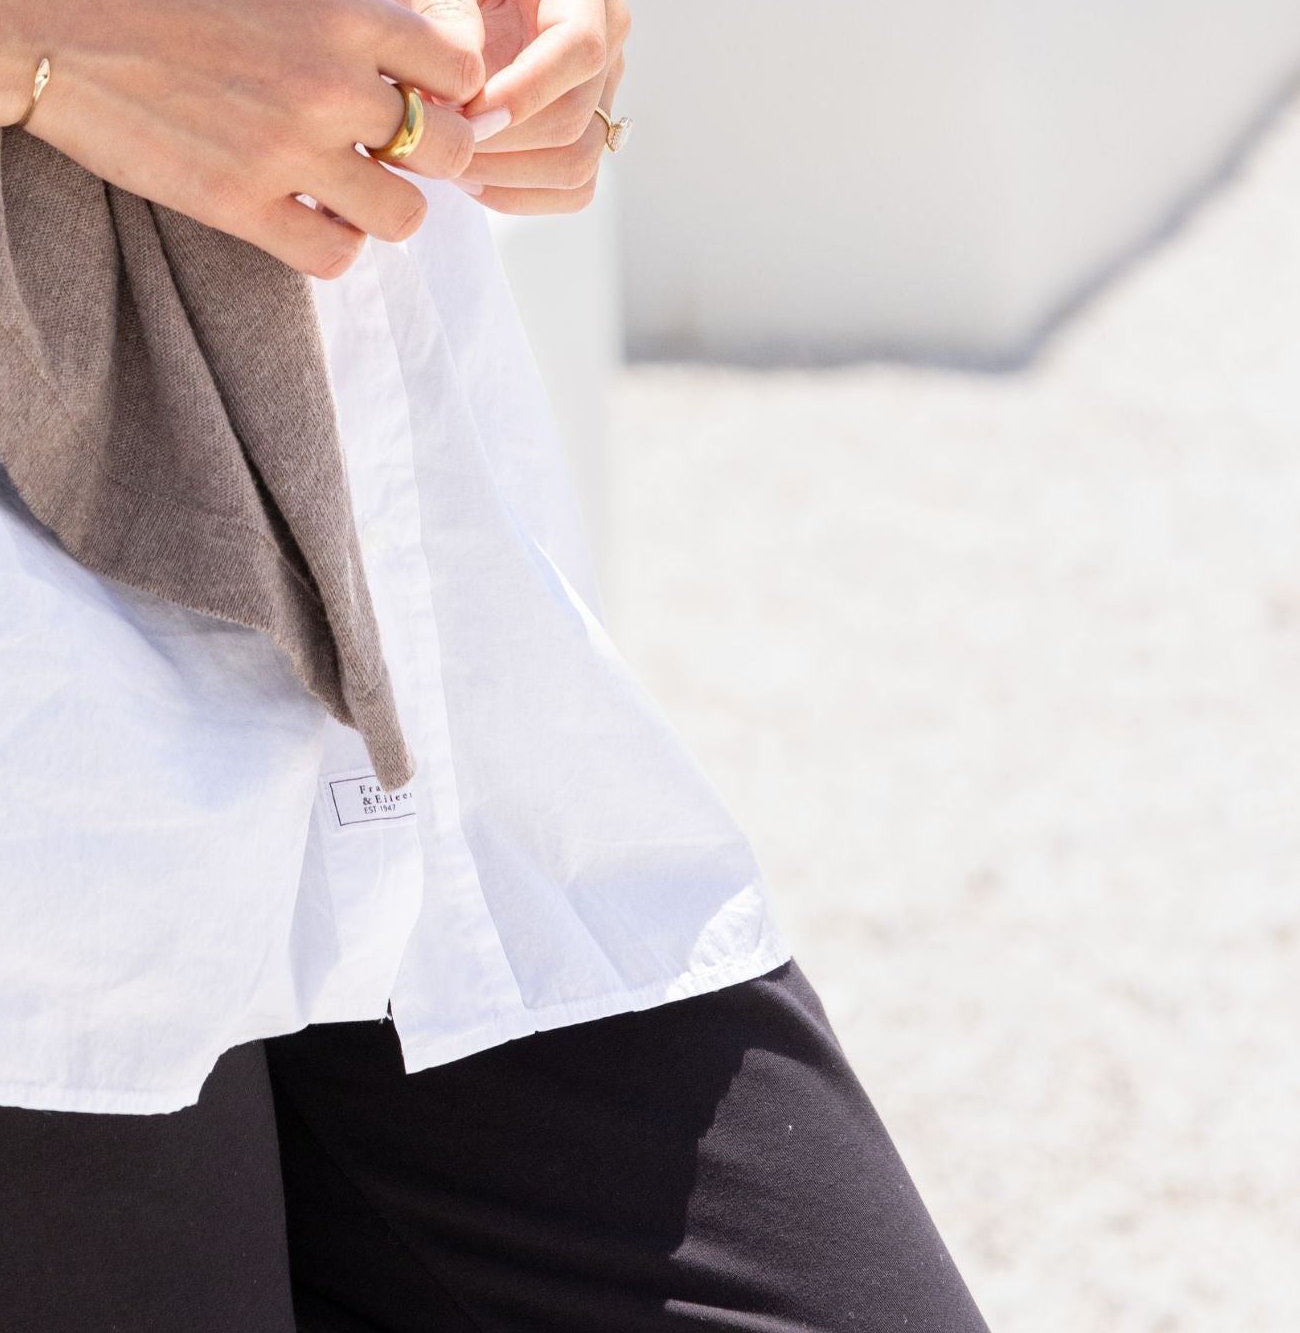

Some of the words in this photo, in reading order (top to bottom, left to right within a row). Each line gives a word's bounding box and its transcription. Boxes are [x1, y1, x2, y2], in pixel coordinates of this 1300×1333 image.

[359, 785, 381, 794] Fra
[364, 805, 377, 814] EST
[380, 804, 396, 813] 1947
